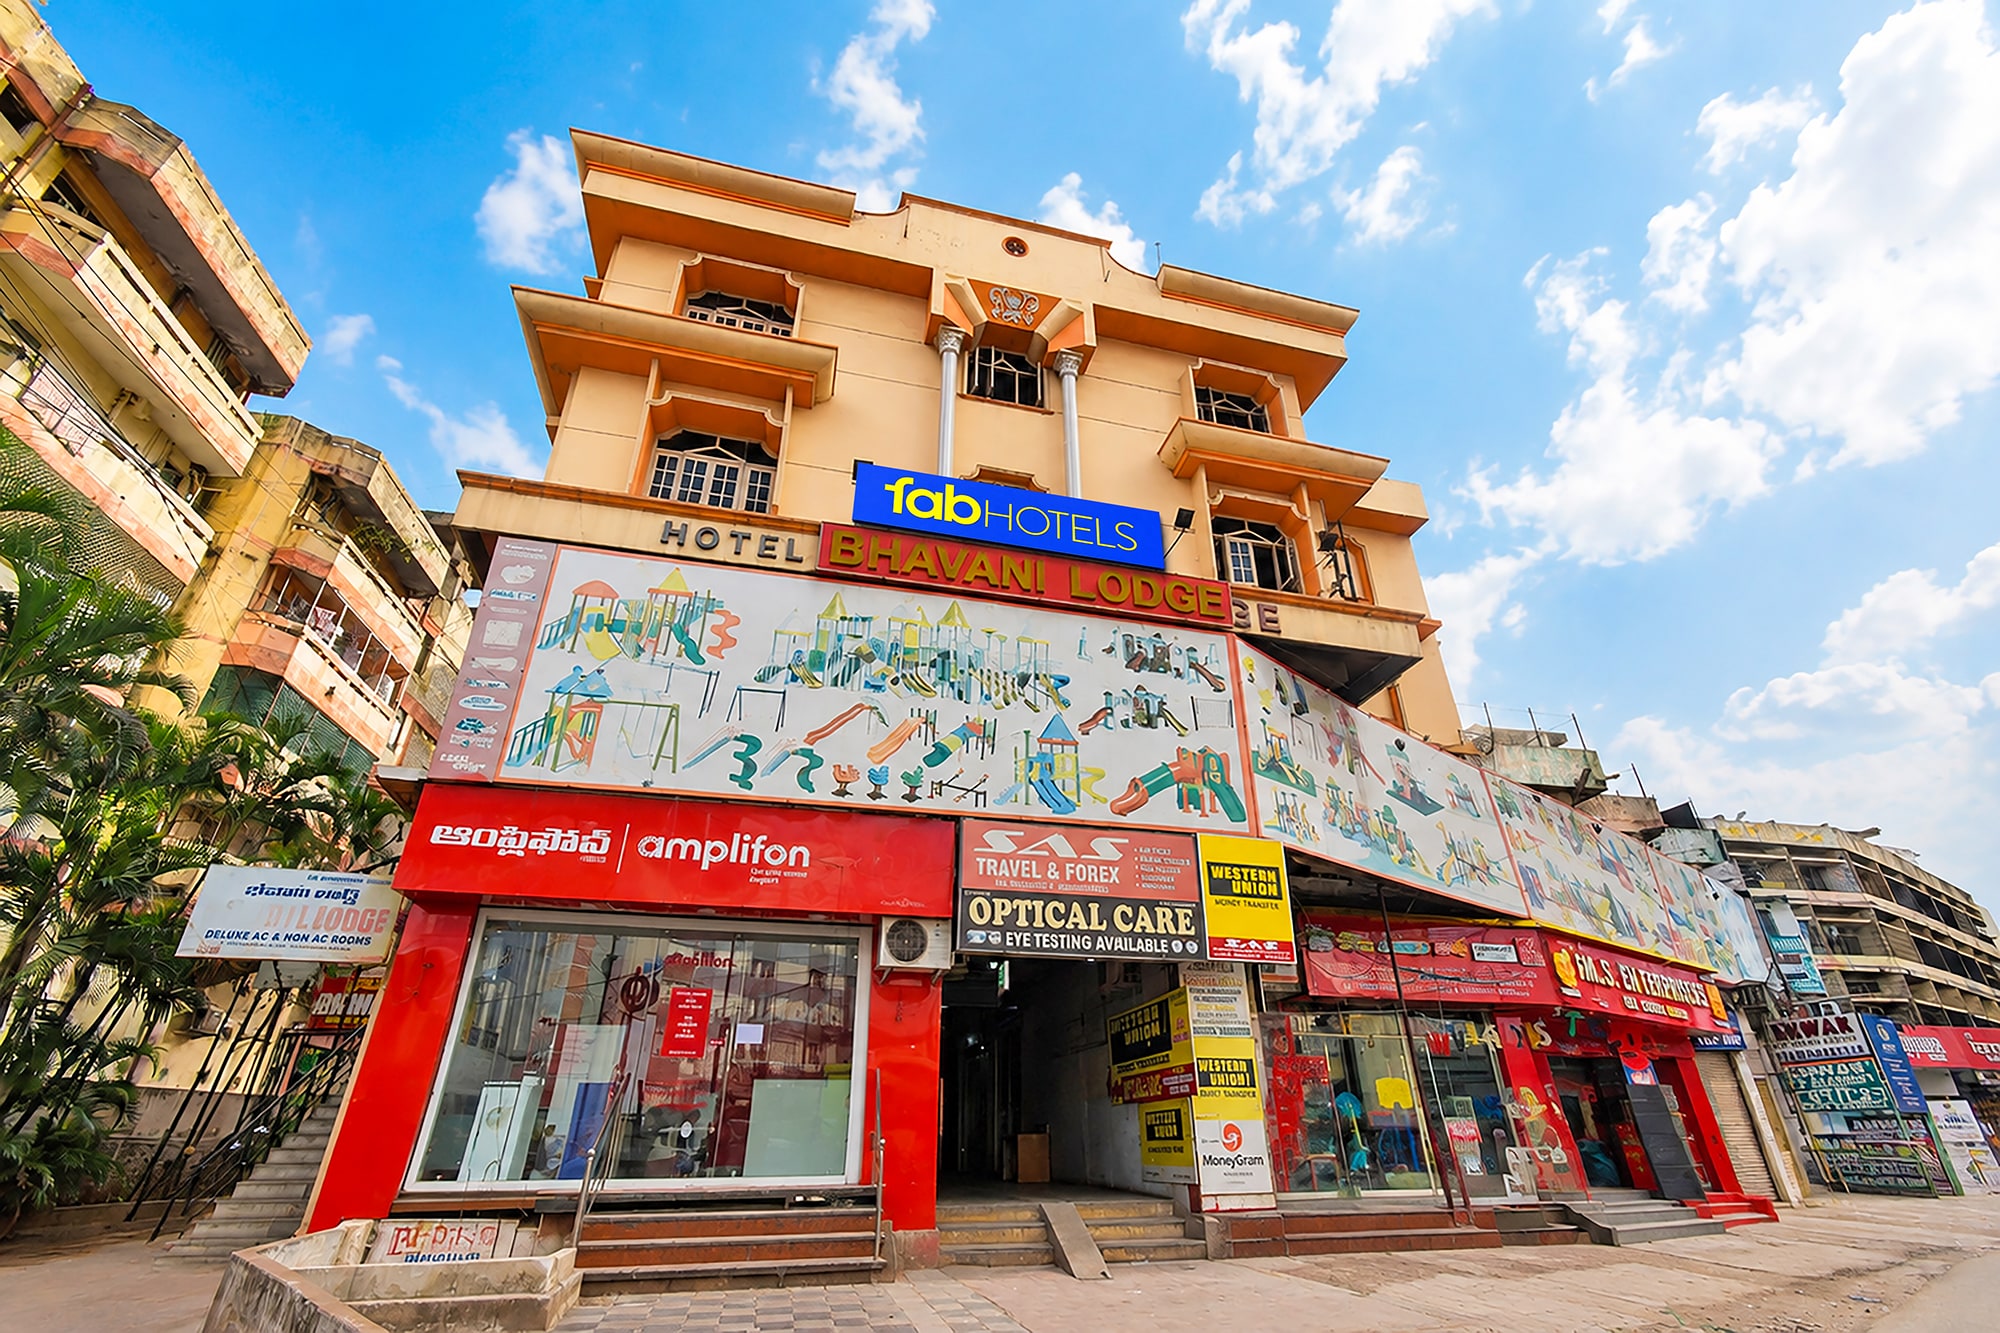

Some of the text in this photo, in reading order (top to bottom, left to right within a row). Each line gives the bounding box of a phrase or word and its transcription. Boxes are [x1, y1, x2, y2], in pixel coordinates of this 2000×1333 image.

[660, 520, 803, 563] HOTEL
[829, 529, 1226, 618] BHAVANI LODGE
[637, 832, 810, 870] amplifon
[974, 829, 1130, 861] SAS
[975, 857, 1042, 879] TRAVEL
[1046, 862, 1060, 879] &
[1065, 864, 1120, 884] FOREX
[1210, 865, 1277, 882] WESTERN
[1231, 880, 1279, 897] UNION
[968, 896, 1197, 935] OPTICAL CARE
[204, 929, 250, 941] DELUXE
[252, 931, 269, 941] AC
[271, 932, 280, 941] &
[284, 932, 312, 943] NON
[313, 934, 329, 944] AC
[331, 934, 373, 947] ROOMS
[1006, 932, 1169, 953] EYE TESTING AVAILABLE
[1202, 1154, 1265, 1169] MoneyGram
